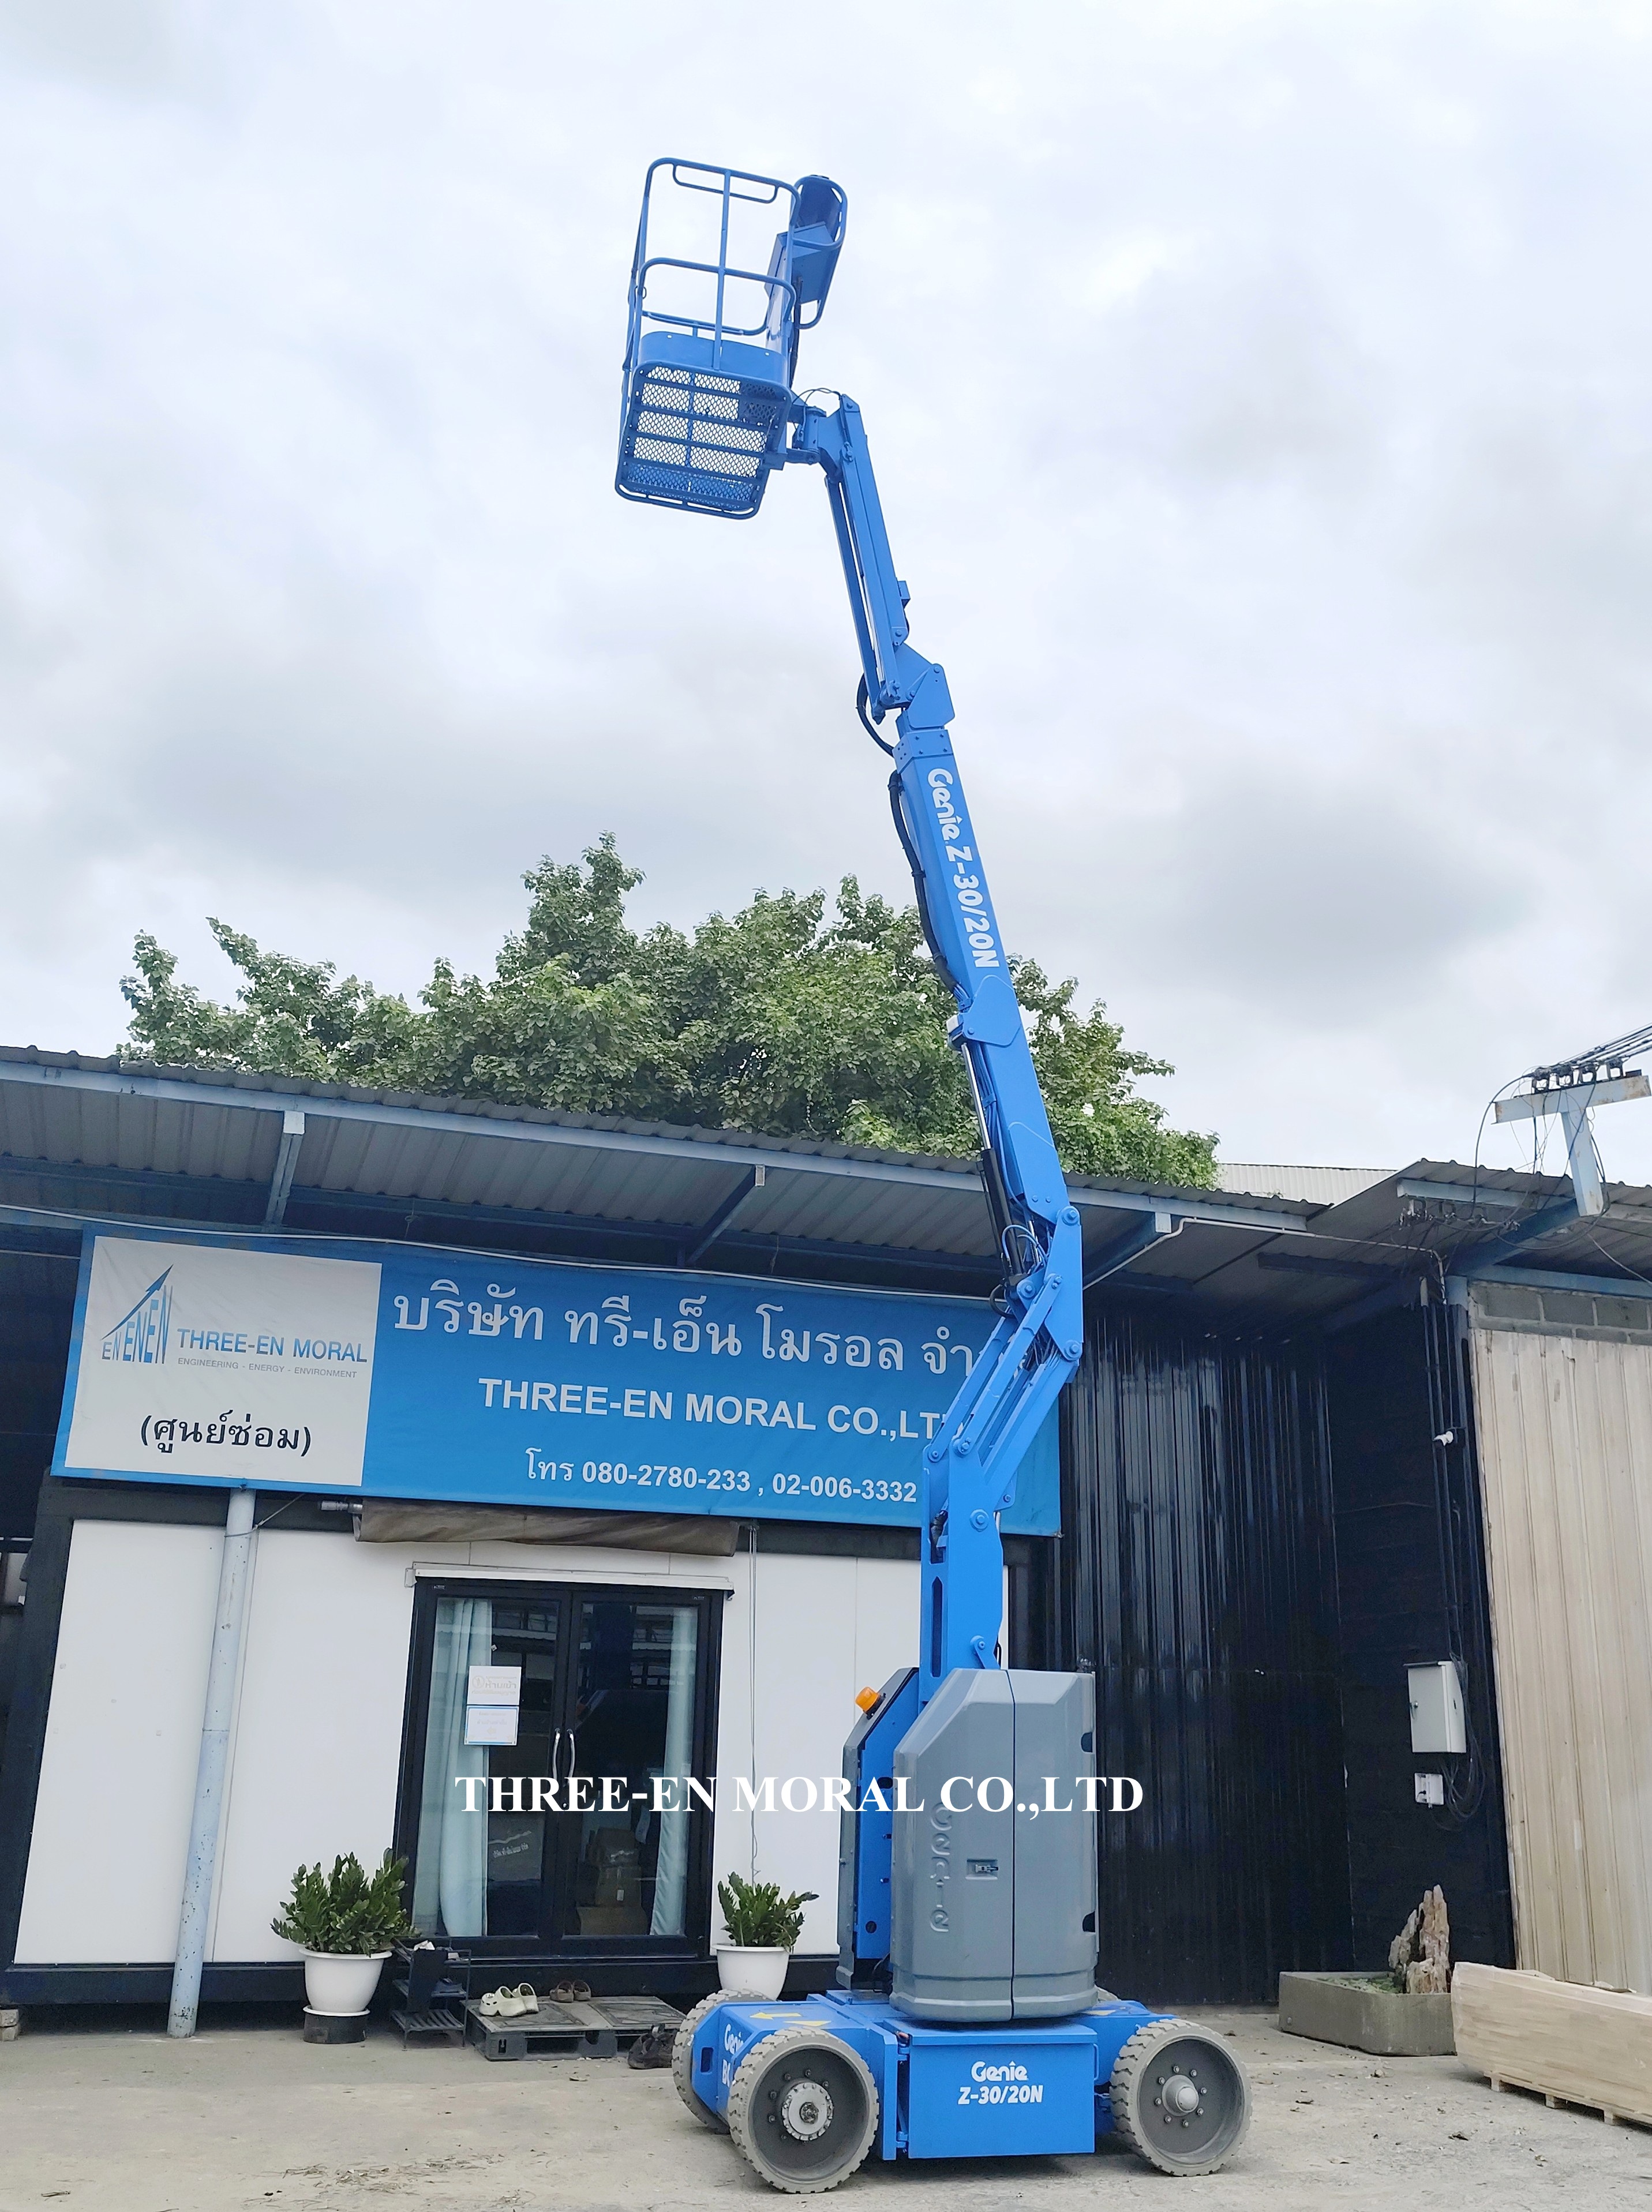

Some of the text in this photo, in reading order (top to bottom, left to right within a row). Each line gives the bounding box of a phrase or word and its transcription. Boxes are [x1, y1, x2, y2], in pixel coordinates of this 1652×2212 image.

[928, 768, 1000, 968] Genie Z-30/20N
[177, 1328, 367, 1363] THREE-EN MORAL
[394, 1279, 544, 1340] บริษัท
[564, 1295, 742, 1356] ทรี-เอ็น
[756, 1303, 904, 1371] โมรอล
[178, 1358, 238, 1369] ENGINEERING
[249, 1363, 284, 1373] ENERGY
[294, 1367, 357, 1378] ENVIRONMENT
[478, 1378, 672, 1420] THREE-EN
[686, 1394, 816, 1430] MORAL
[140, 1409, 311, 1456] (ศูนย์ซ่อม)
[526, 1448, 574, 1482] โทร
[582, 1462, 750, 1492] 080-2780-233
[773, 1473, 916, 1503] 02-006-3332
[725, 2024, 744, 2054] Geni
[971, 2061, 1028, 2082] Genie
[958, 2085, 1043, 2105] Z-30/20N
